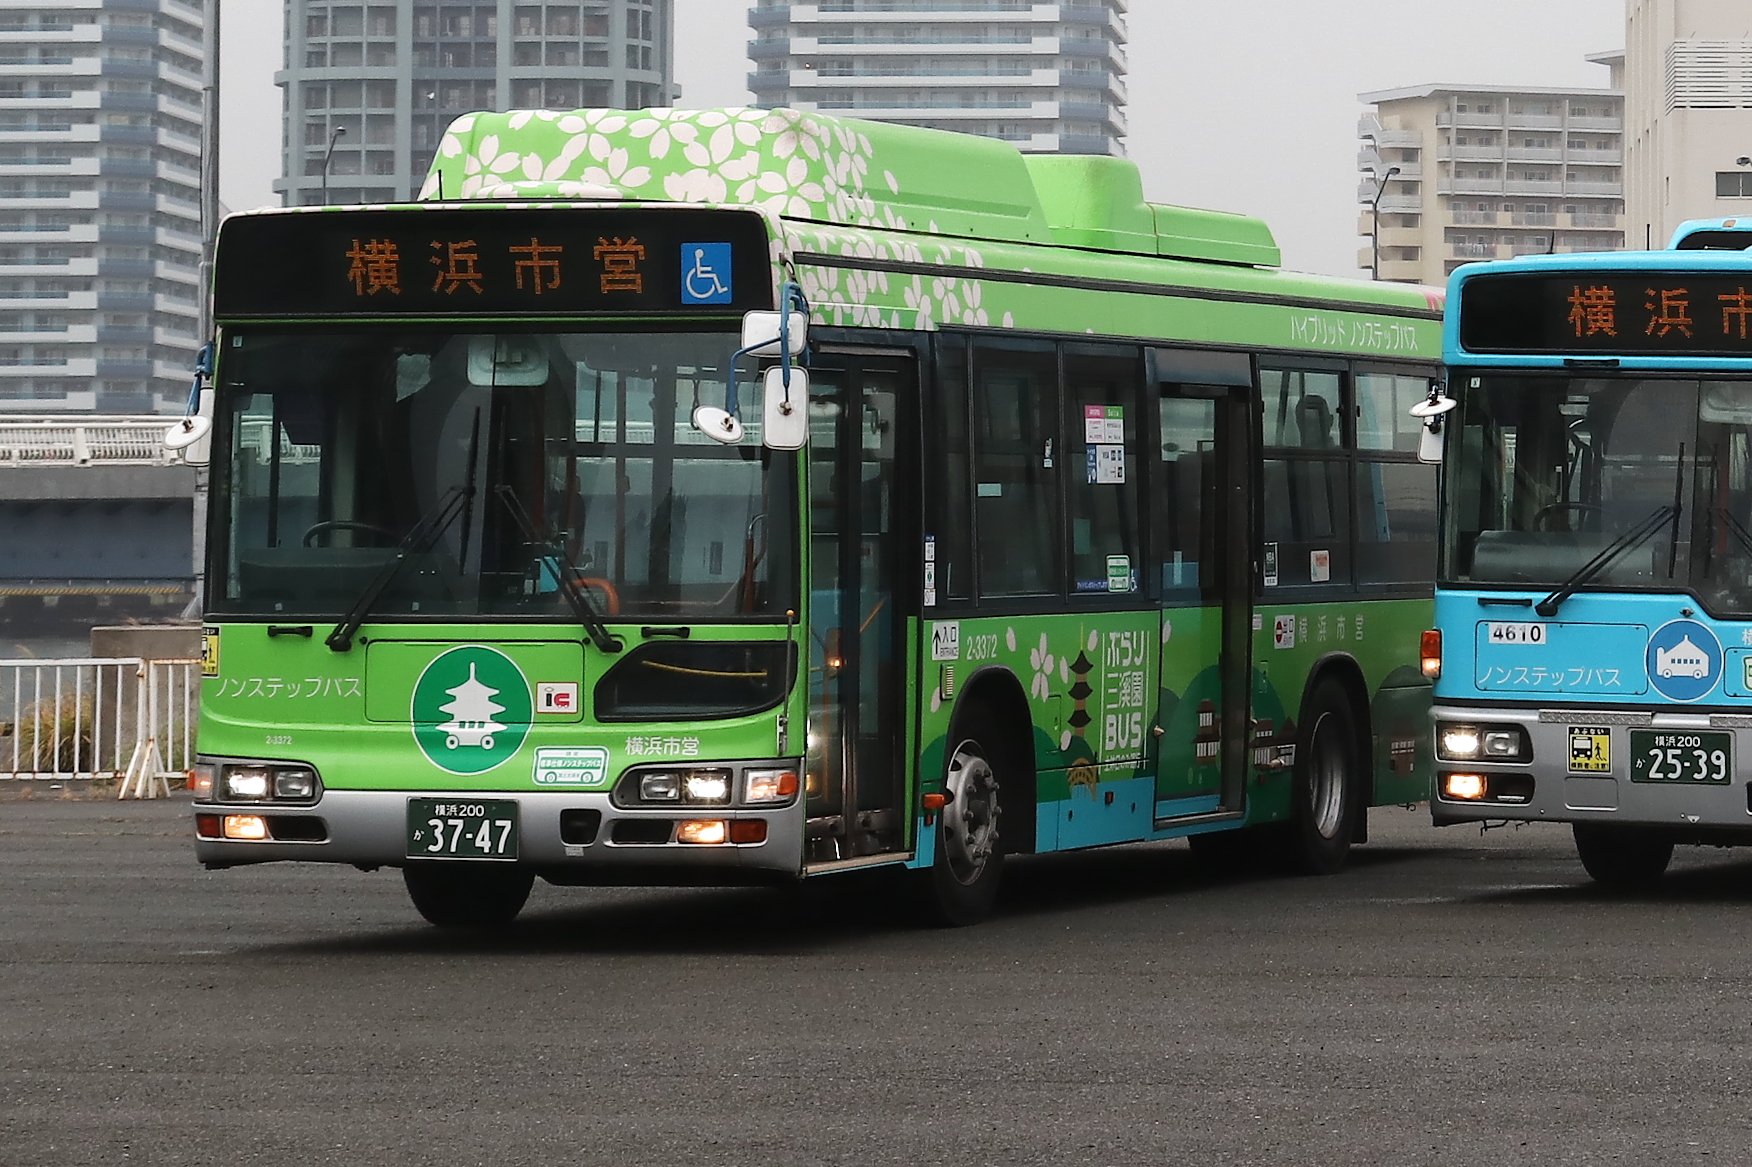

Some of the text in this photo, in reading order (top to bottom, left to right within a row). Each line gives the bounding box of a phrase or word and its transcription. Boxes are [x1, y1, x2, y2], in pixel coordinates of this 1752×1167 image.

[346, 237, 646, 295] 横浜市営
[1350, 322, 1418, 351] ノンステップバス
[942, 626, 957, 643] 入口
[1493, 625, 1542, 642] 4610
[966, 634, 998, 660] 2-3372
[215, 677, 362, 698] ノンステップバス
[1479, 667, 1621, 687] ノンステップバス
[1105, 712, 1142, 751] BUS
[625, 736, 700, 756] 横浜市営
[1648, 748, 1726, 780] 25-39
[427, 818, 512, 853] 37-47
